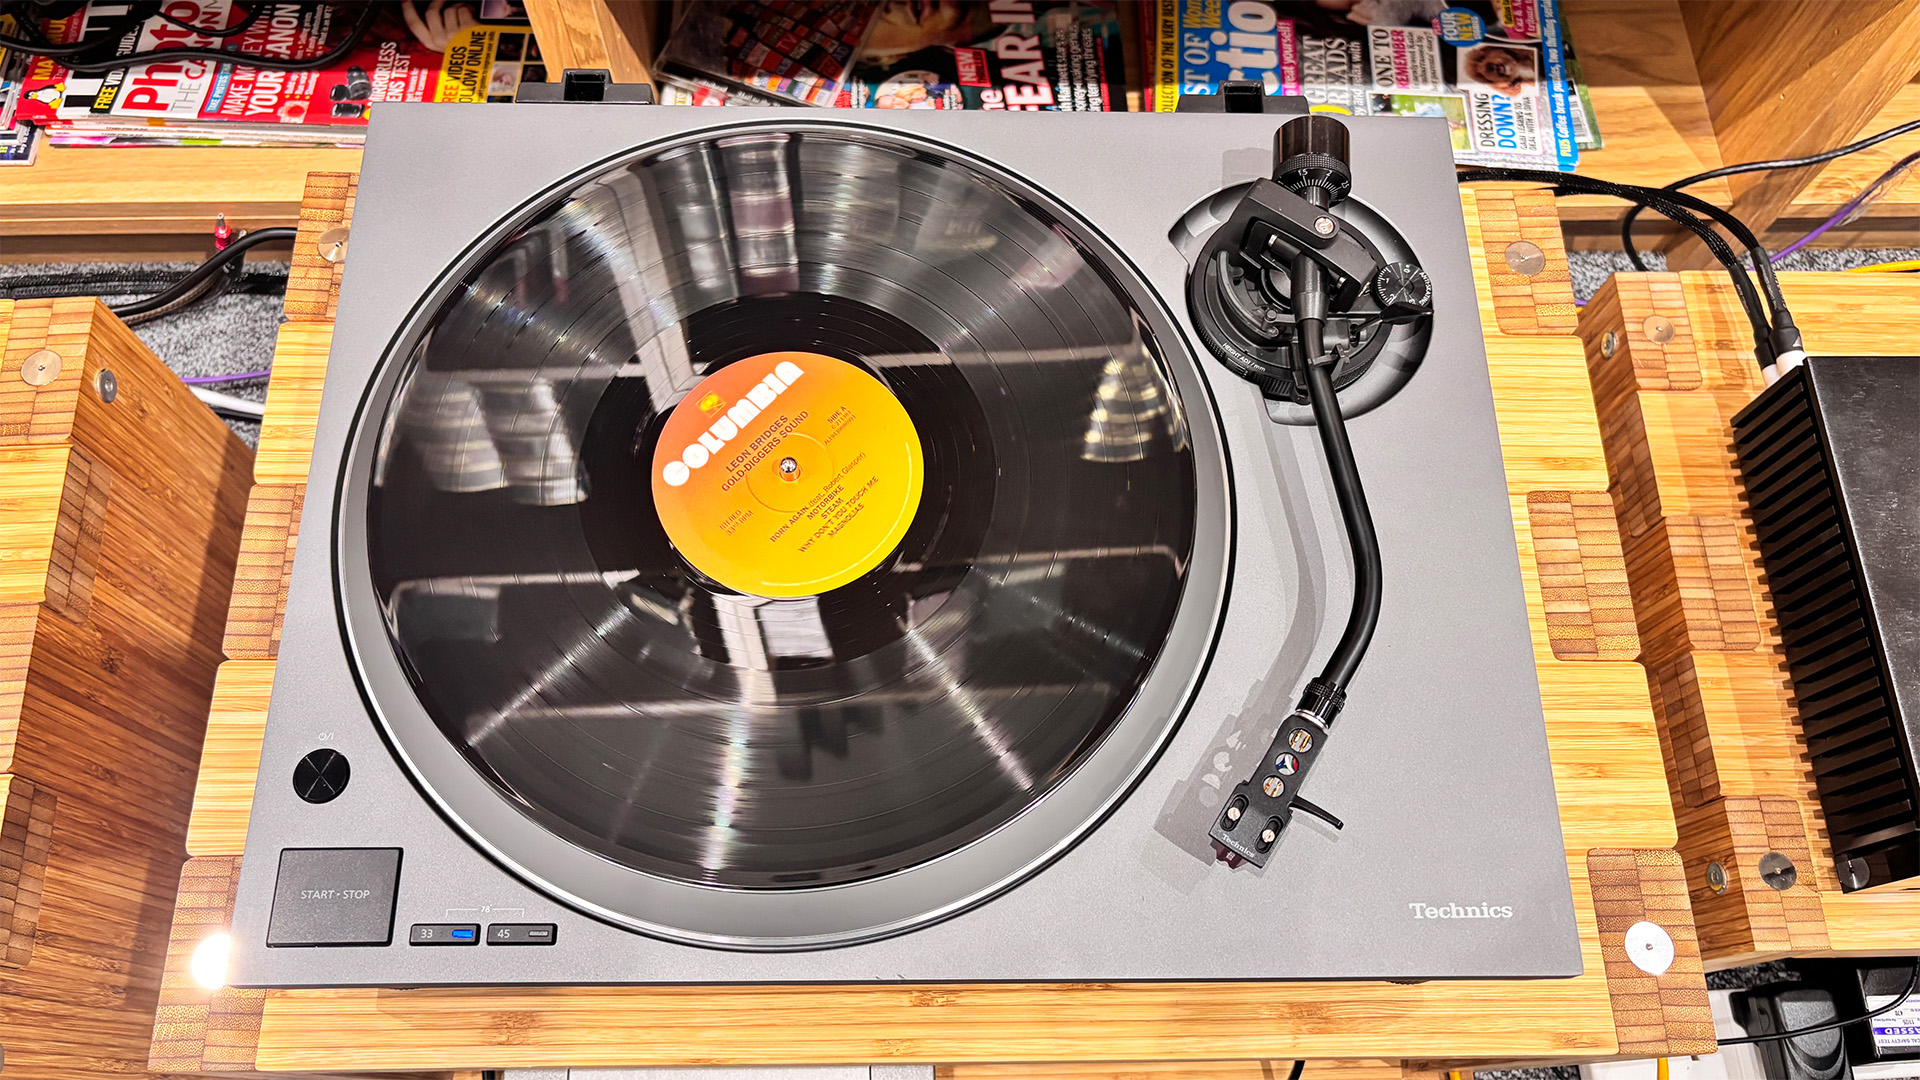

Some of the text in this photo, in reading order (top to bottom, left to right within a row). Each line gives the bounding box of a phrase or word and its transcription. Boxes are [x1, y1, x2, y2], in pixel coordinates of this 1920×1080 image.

[1161, 19, 1174, 39] VERY
[1440, 12, 1459, 41] FOUR
[1456, 13, 1474, 41] NEW
[1542, 18, 1557, 47] thrilling
[1082, 28, 1094, 59] threats
[1161, 41, 1174, 56] THE
[1183, 33, 1210, 65] OF
[1278, 22, 1296, 64] yourself!
[1348, 42, 1361, 62] with
[1548, 49, 1558, 63] two
[459, 31, 486, 103] OLLOW ONLINE
[956, 51, 977, 81] NEW
[1161, 58, 1174, 69] OF
[1302, 35, 1327, 103] GREAT
[1325, 37, 1351, 105] READS
[1372, 29, 1394, 87] ONE TO
[1390, 30, 1410, 89] REMEMBER
[105, 68, 126, 86] VID
[212, 76, 229, 98] PHOTOS
[386, 53, 411, 102] ENS TEST
[442, 46, 466, 103] REE VIDEOS
[1070, 54, 1087, 112] oney-making
[1183, 69, 1211, 95] ST
[1283, 66, 1297, 88] treat
[1550, 64, 1564, 92] puzzles,
[95, 85, 118, 109] FREE
[171, 82, 202, 112] THE
[221, 84, 253, 115] MAKE
[245, 71, 286, 115] YOUR
[1161, 72, 1174, 113] OLLECTION
[1552, 93, 1565, 114] break
[1475, 94, 1495, 147] DRESSING
[1490, 95, 1517, 149] DOWN?
[1516, 111, 1525, 133] LEARNS
[1525, 119, 1534, 134] WITH
[1556, 115, 1569, 138] Coffee
[1528, 136, 1537, 151] DEAL
[1558, 139, 1572, 157] PLUS
[1222, 342, 1241, 358] HEIGHT
[662, 361, 804, 487] COLUMBIA
[827, 409, 842, 424] SIDE
[720, 436, 781, 492] GOLD-DIGGERS
[779, 410, 809, 439] SOUND
[726, 414, 788, 473] LEON BRIDGES
[769, 451, 867, 543] BORN AGAIN (feat. Robert Glasper)
[806, 484, 844, 521] MOTORBIKE
[820, 497, 844, 520] STEAM
[798, 475, 879, 554] WHY DON'T YOU TOUCH ME
[827, 502, 865, 539] MAGNOLIAS
[1222, 833, 1255, 858] Technics
[300, 889, 370, 900] START STOP
[1408, 901, 1513, 919] Technics
[420, 929, 433, 939] 33
[497, 929, 510, 939] 45
